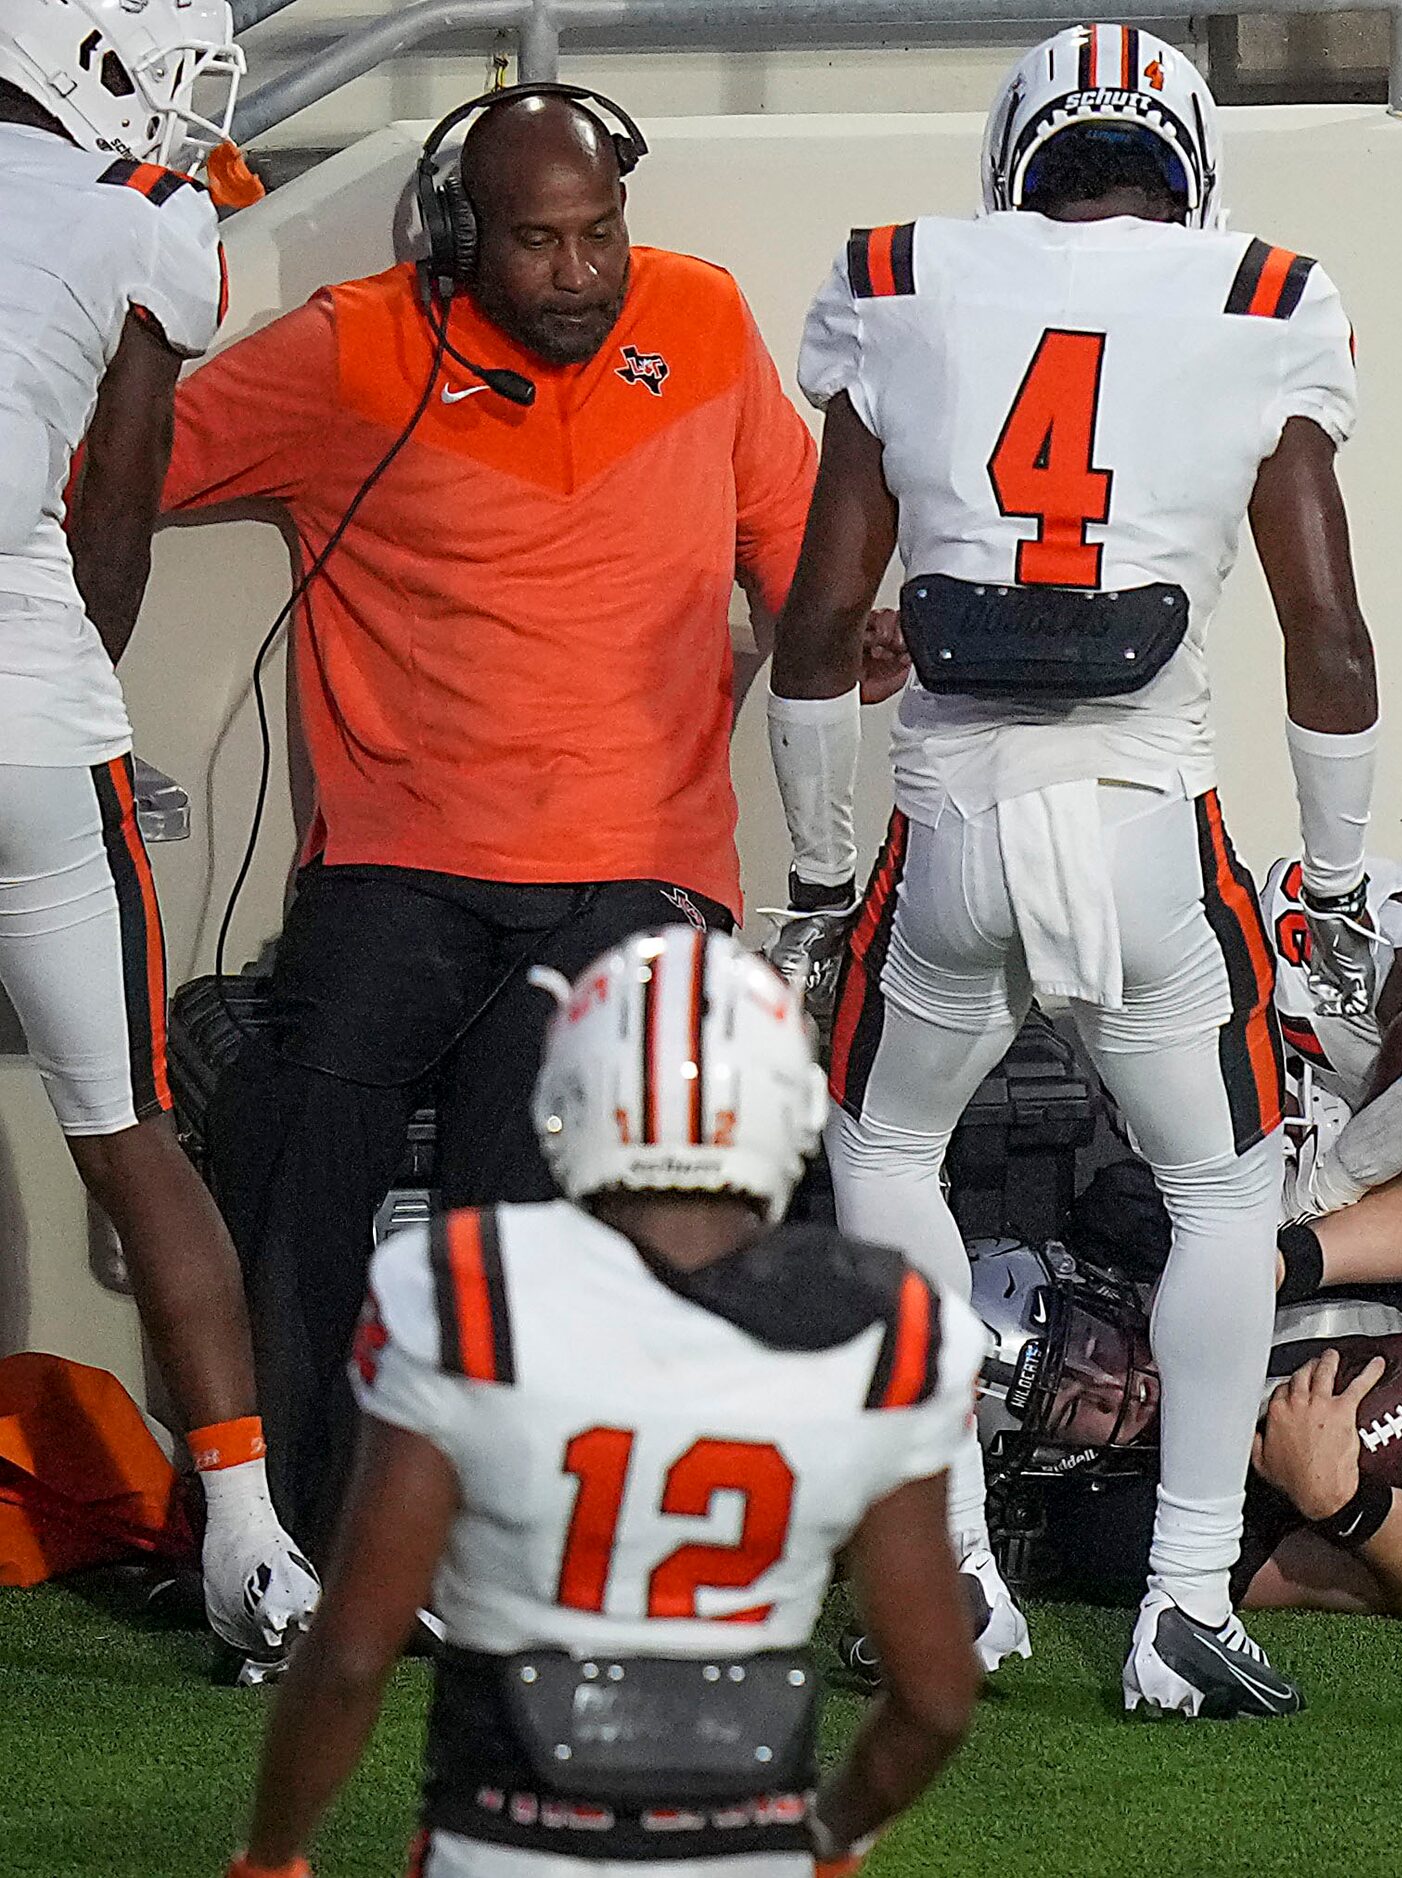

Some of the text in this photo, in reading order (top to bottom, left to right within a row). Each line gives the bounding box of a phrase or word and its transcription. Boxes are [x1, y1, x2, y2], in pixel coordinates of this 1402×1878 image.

[1065, 88, 1150, 110] schutt
[1144, 59, 1165, 91] 4
[986, 328, 1113, 590] 4
[713, 1109, 736, 1146] 2
[1010, 1340, 1042, 1408] WILDCATS
[555, 1427, 796, 1624] 12
